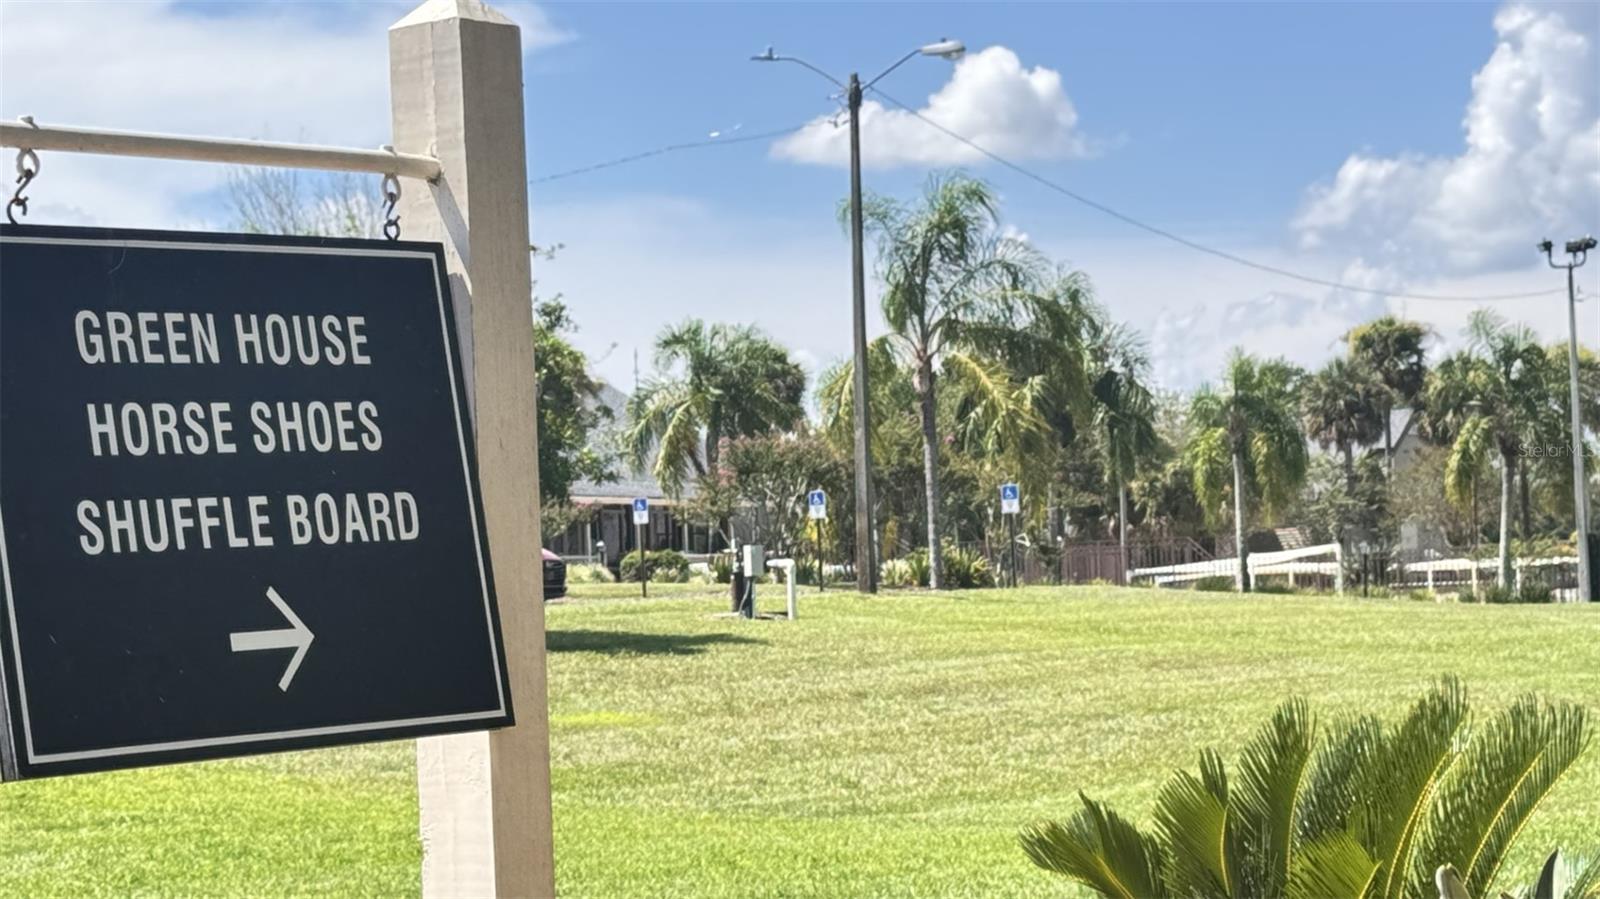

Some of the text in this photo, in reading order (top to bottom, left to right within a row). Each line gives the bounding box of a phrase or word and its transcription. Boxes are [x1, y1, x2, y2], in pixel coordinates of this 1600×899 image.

[75, 310, 372, 366] GREEN HOUSE
[86, 400, 383, 457] HORSE SHOES
[76, 491, 420, 555] SHUFFLE BOARD
